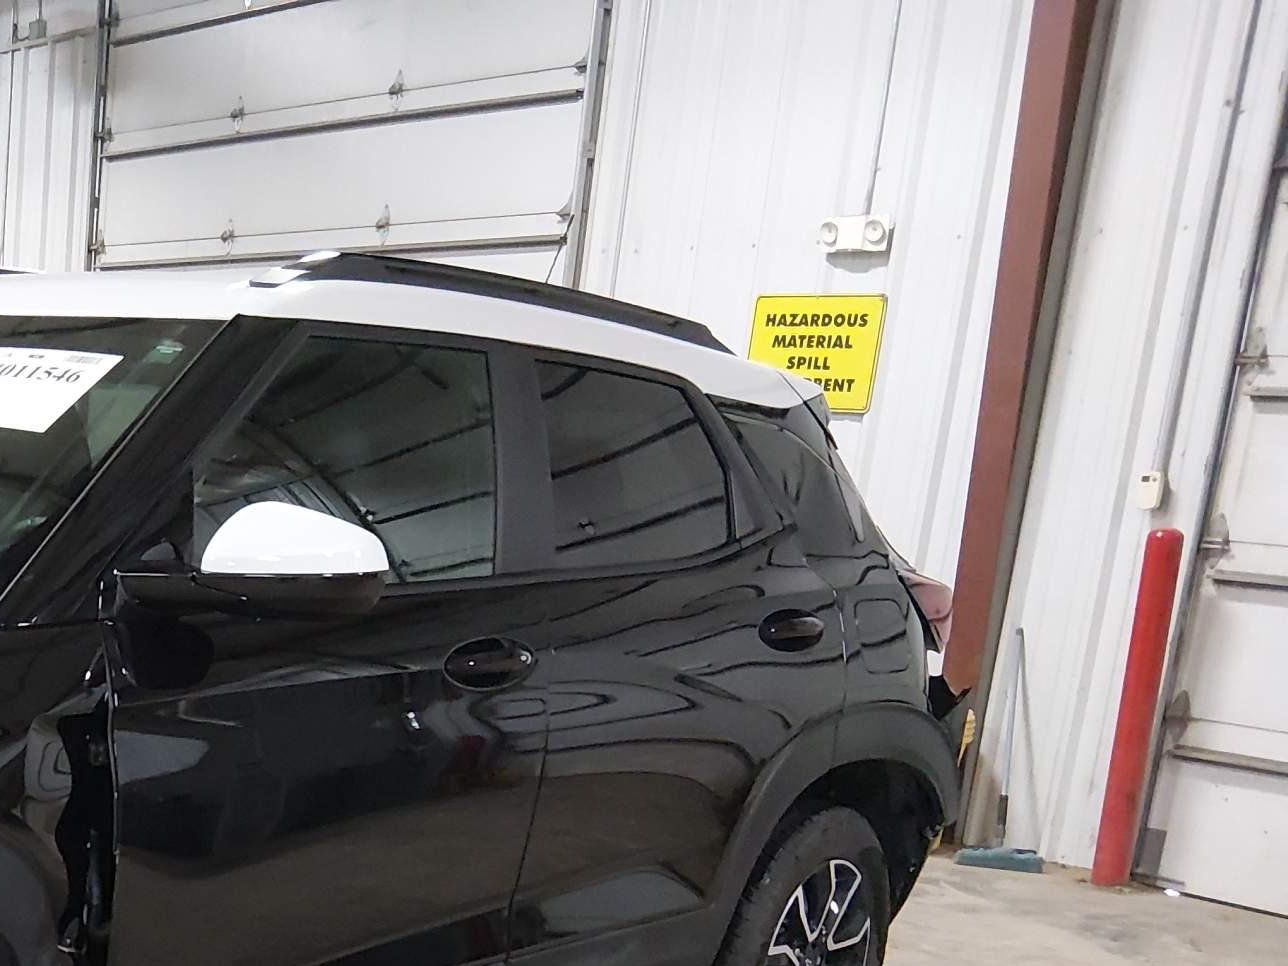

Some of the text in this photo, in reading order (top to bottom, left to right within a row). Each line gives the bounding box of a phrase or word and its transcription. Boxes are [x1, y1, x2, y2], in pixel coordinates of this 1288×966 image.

[765, 313, 869, 327] HAZARDOUS
[772, 335, 853, 349] MATERIAL
[786, 356, 831, 370] SPILL
